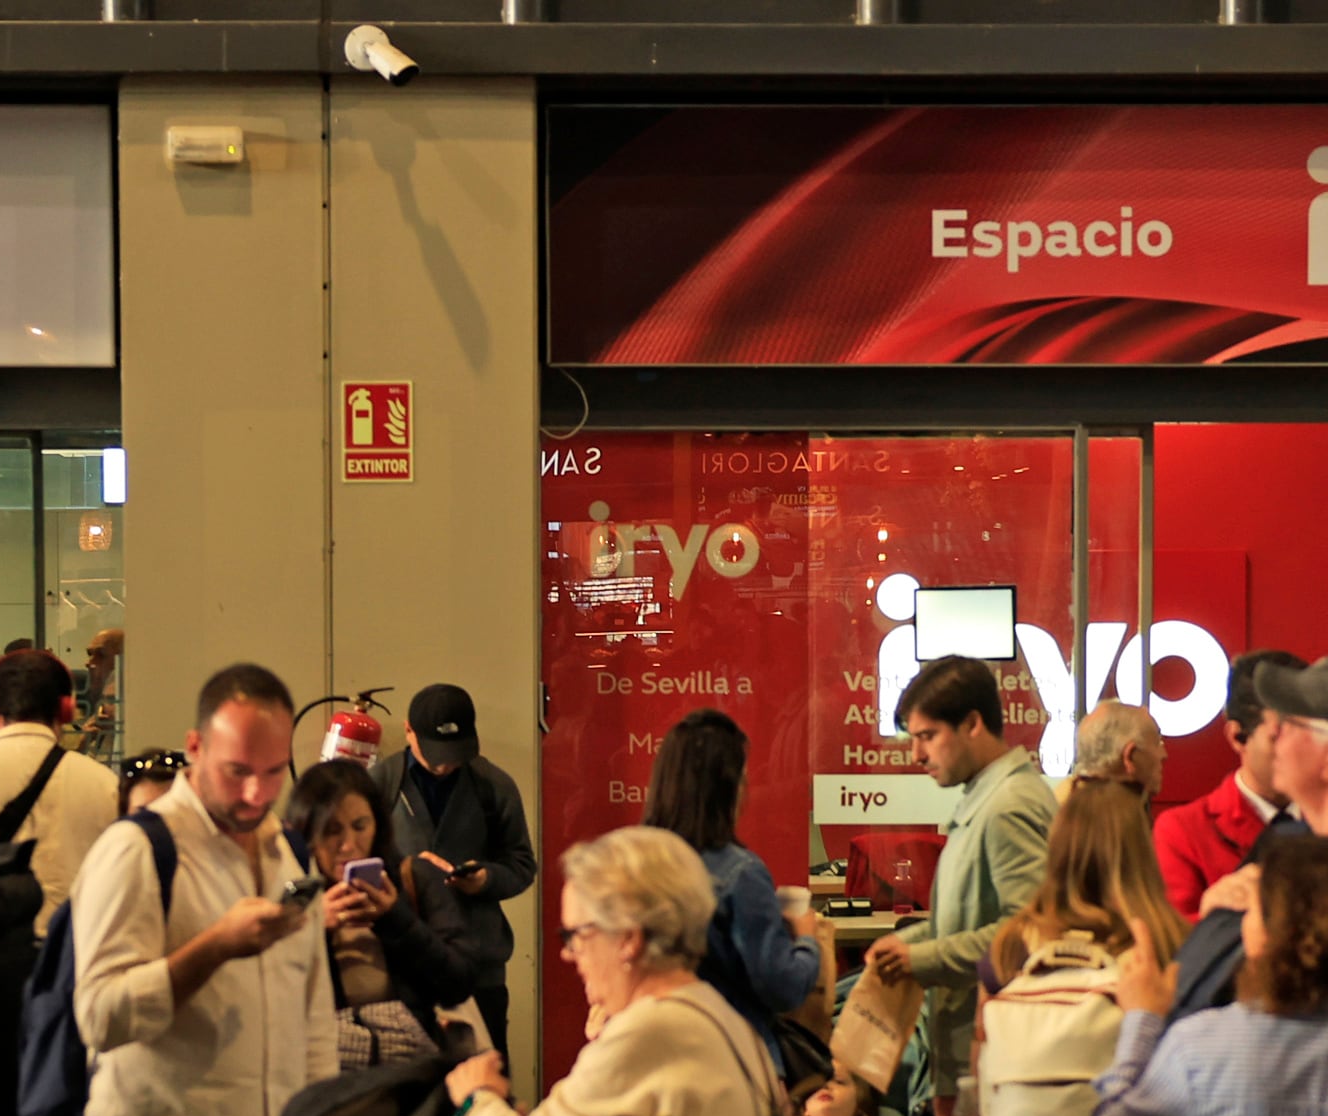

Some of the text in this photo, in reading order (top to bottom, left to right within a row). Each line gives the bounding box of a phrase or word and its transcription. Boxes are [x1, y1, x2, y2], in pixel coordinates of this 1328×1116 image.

[931, 206, 1173, 272] Espacio
[347, 459, 408, 474] EXTINTOR
[588, 500, 760, 601] iryo
[597, 671, 753, 695] De Sevilla a
[840, 785, 888, 812] iryo
